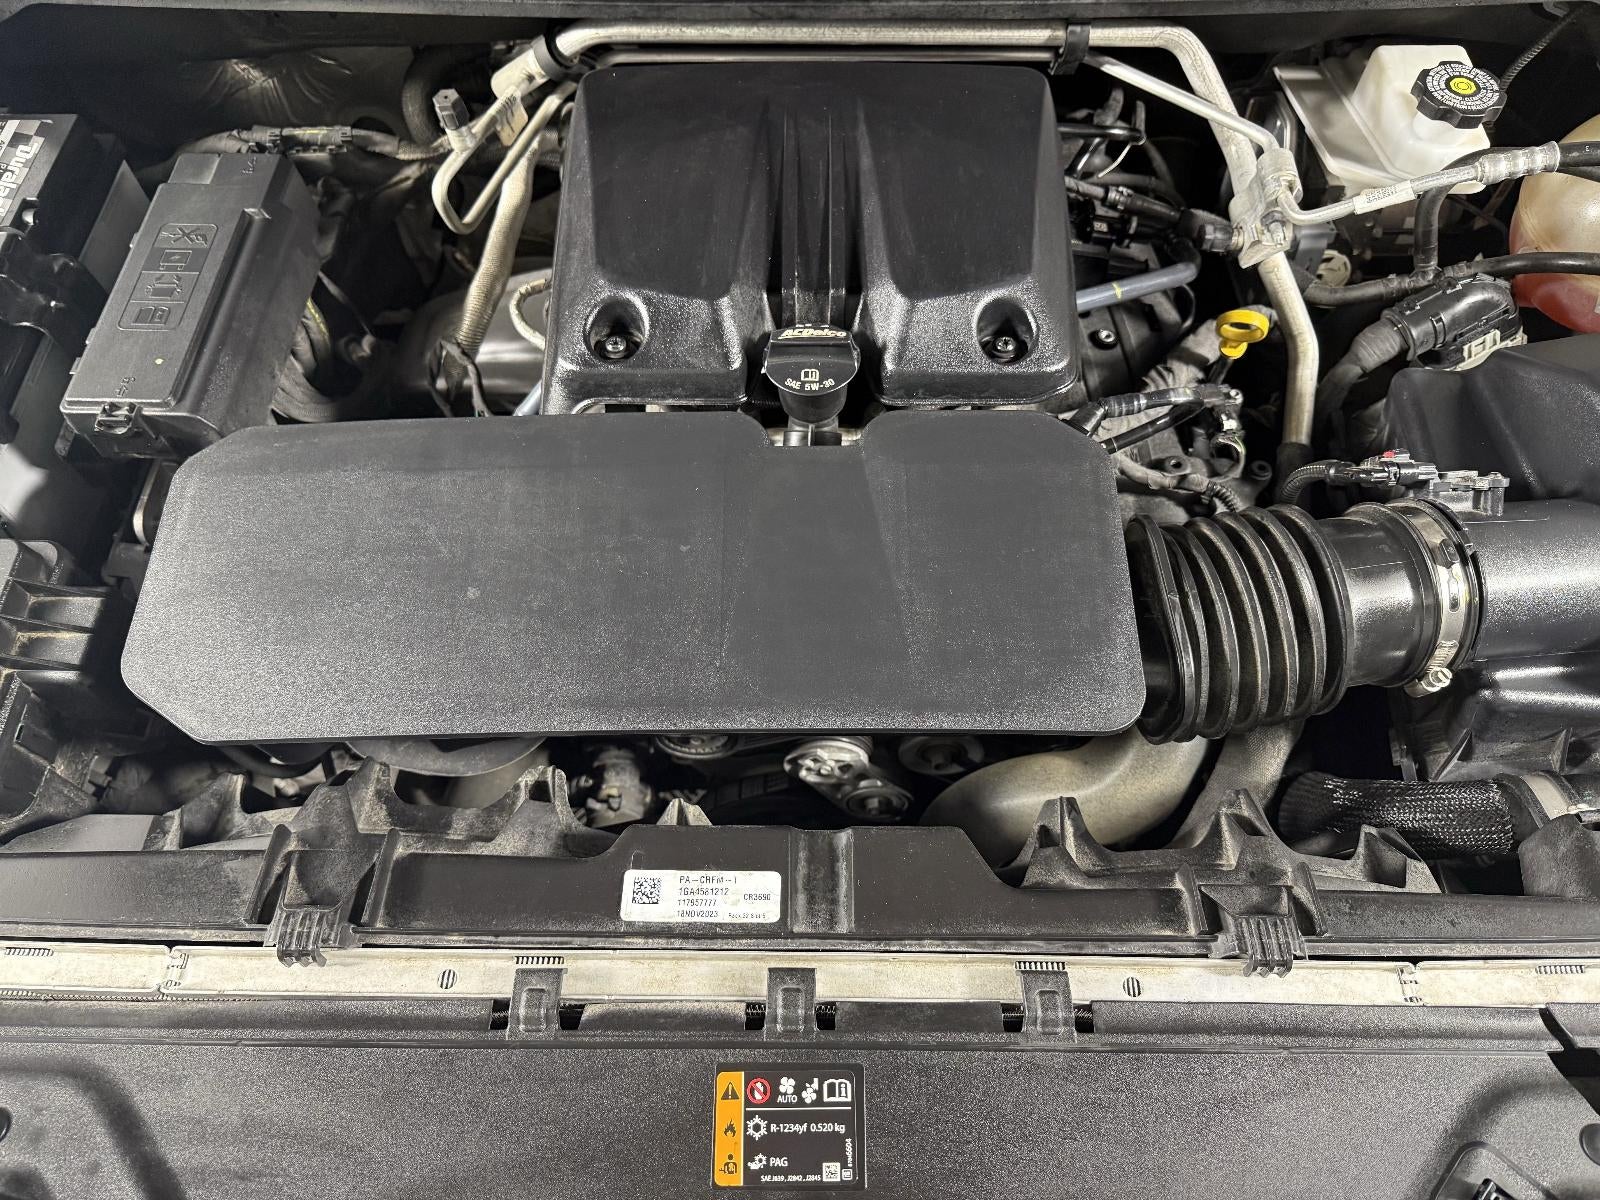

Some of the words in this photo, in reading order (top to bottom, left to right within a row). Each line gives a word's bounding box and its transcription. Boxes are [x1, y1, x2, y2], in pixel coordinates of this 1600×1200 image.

[778, 328, 847, 340] ACDelco
[784, 377, 802, 390] SAE
[777, 1094, 797, 1103] AUTO
[771, 1124, 807, 1134] R-1234yf
[810, 1123, 833, 1133] 0.520
[834, 1122, 846, 1134] kg
[769, 1157, 788, 1167] PAG
